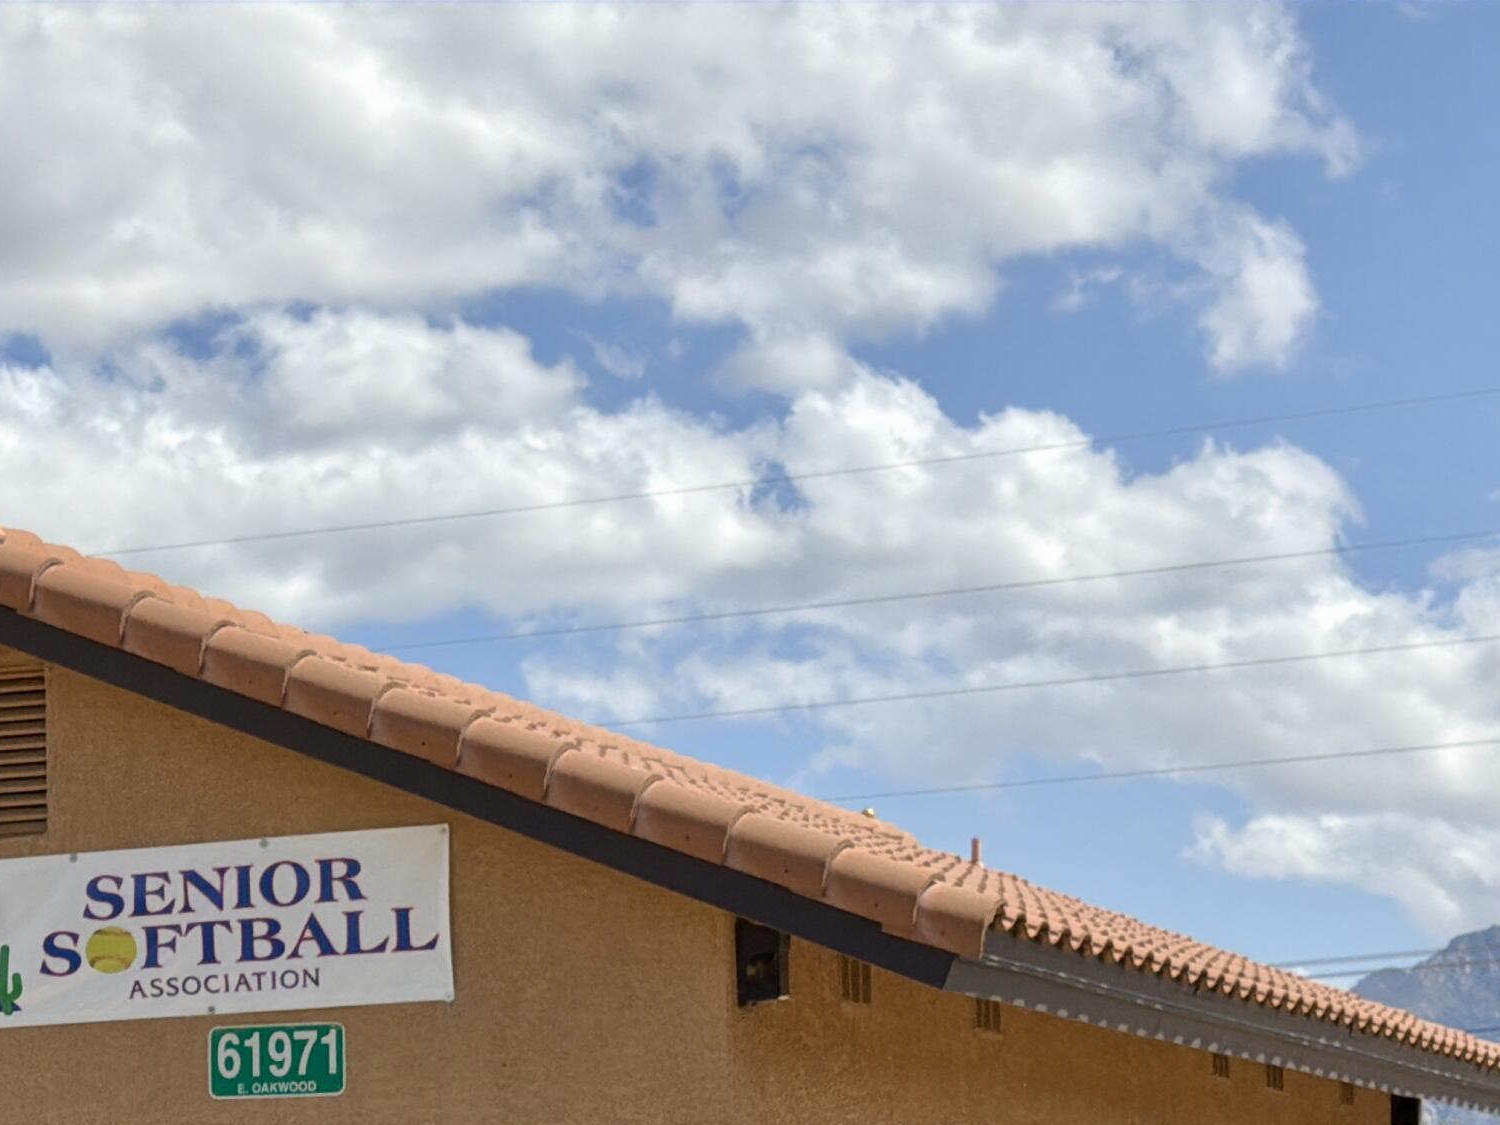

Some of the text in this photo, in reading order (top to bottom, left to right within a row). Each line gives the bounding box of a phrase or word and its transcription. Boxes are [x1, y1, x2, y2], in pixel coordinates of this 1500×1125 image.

[82, 857, 368, 921] SENIOR
[129, 968, 321, 999] ASSOCIATION
[217, 1029, 337, 1079] 61971
[237, 1081, 317, 1094] E. OAKWOOD
